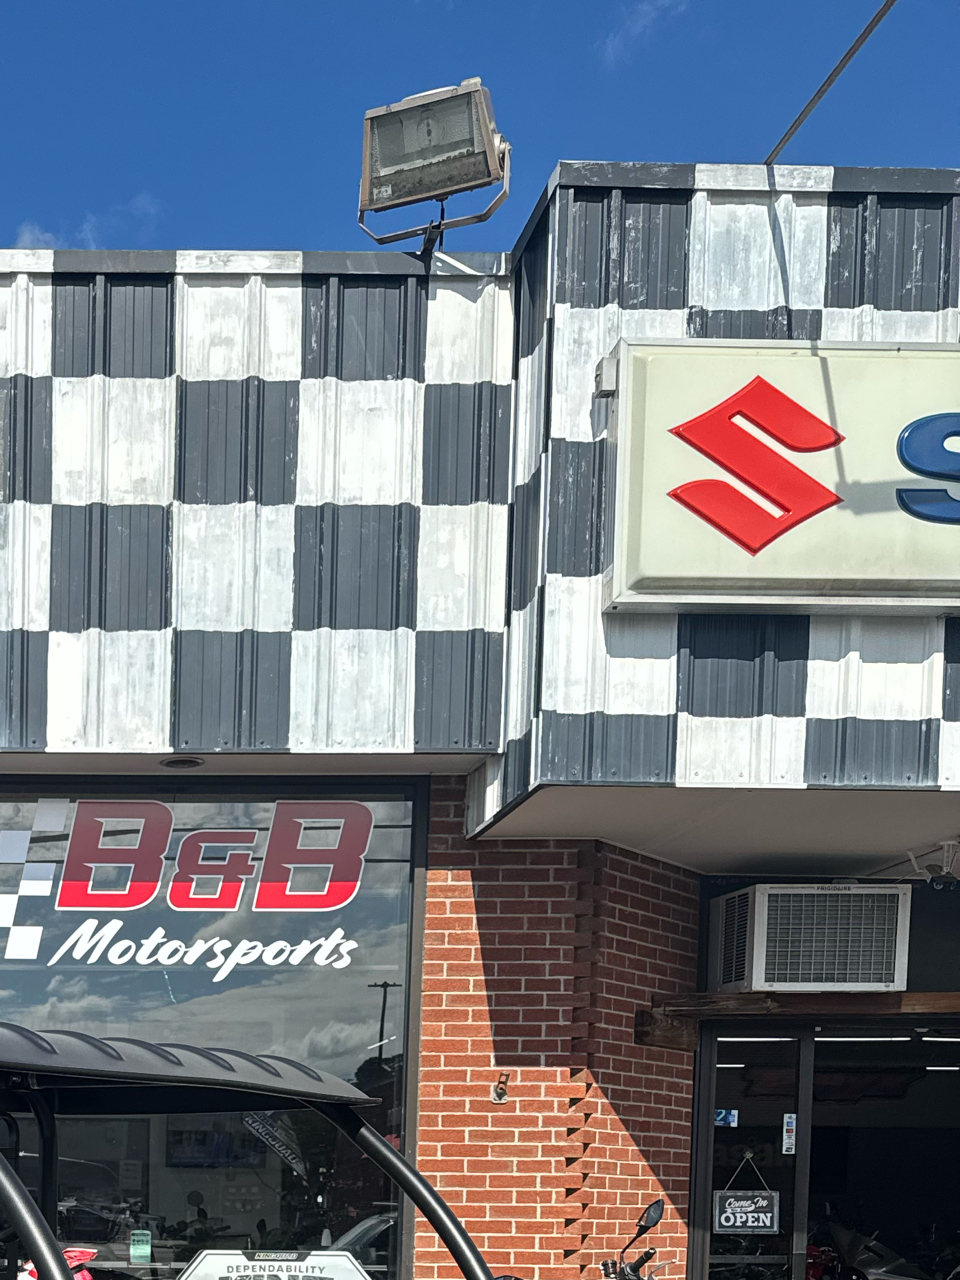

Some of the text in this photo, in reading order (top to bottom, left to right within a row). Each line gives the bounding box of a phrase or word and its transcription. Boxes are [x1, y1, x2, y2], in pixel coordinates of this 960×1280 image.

[54, 799, 375, 912] B&B
[46, 918, 359, 983] Motorsports
[243, 1114, 300, 1164] KINGQUAD
[725, 1197, 768, 1208] Come In
[720, 1213, 772, 1227] OPEN
[254, 1252, 299, 1260] KINGQUAD
[226, 1264, 326, 1275] DEPENDABILITY
